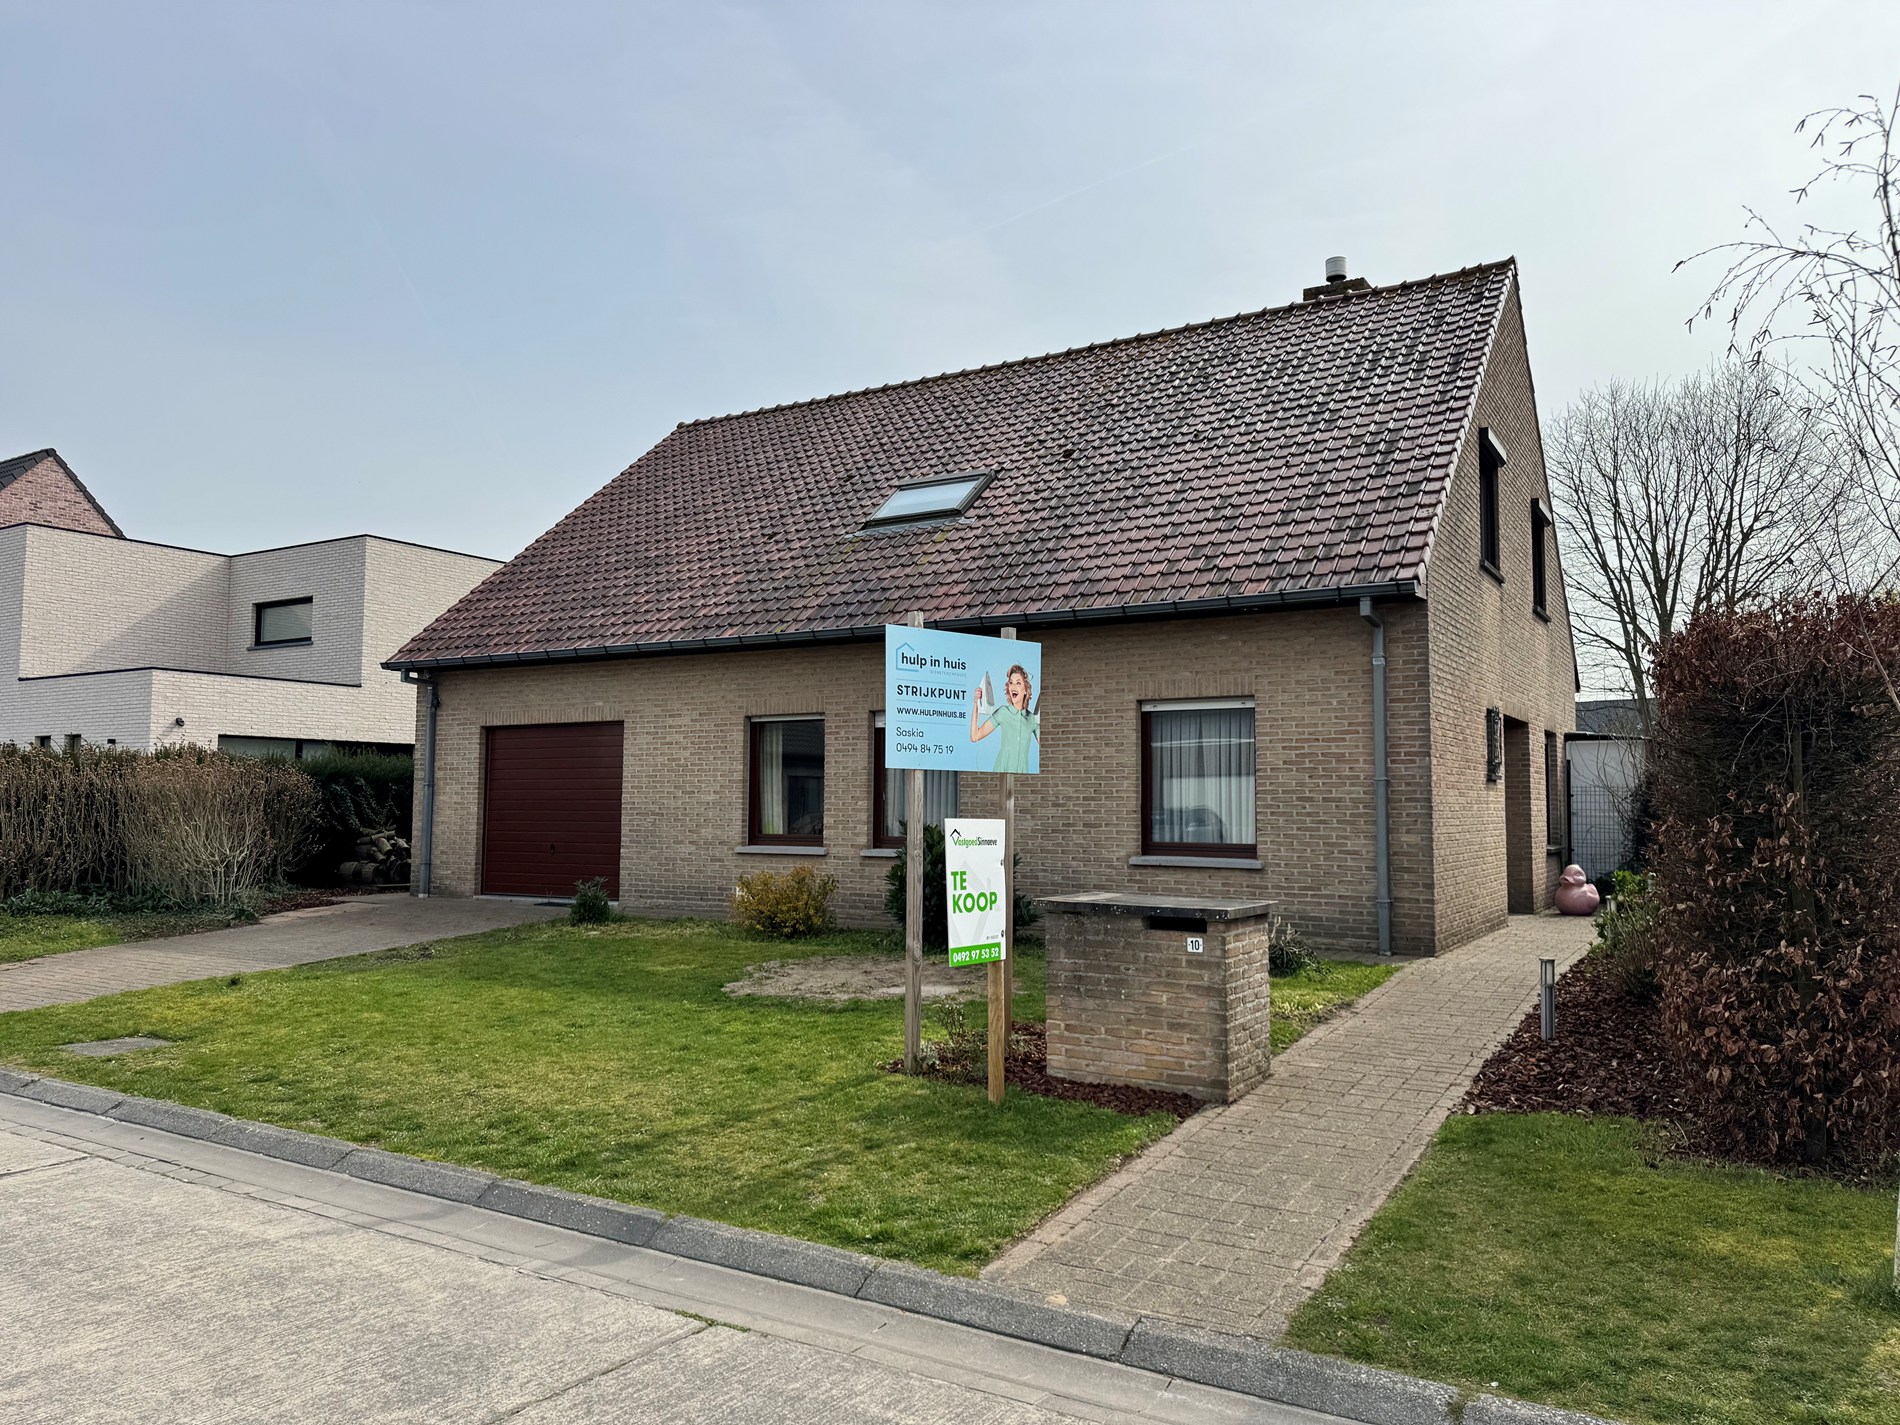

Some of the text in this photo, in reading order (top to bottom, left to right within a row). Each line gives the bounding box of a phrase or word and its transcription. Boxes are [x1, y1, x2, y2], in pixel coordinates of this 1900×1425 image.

[901, 652, 967, 670] hulp in huis
[897, 684, 967, 701] STRIJKPUNT
[896, 707, 967, 719] WWW.HULPINHUIS.BE
[896, 726, 924, 738] Saskia
[896, 742, 954, 755] 0494 84 75 19
[950, 870, 967, 891] TE
[952, 891, 998, 914] KOOP
[1190, 939, 1200, 951] 10
[952, 947, 999, 963] 0492 97 53 52
